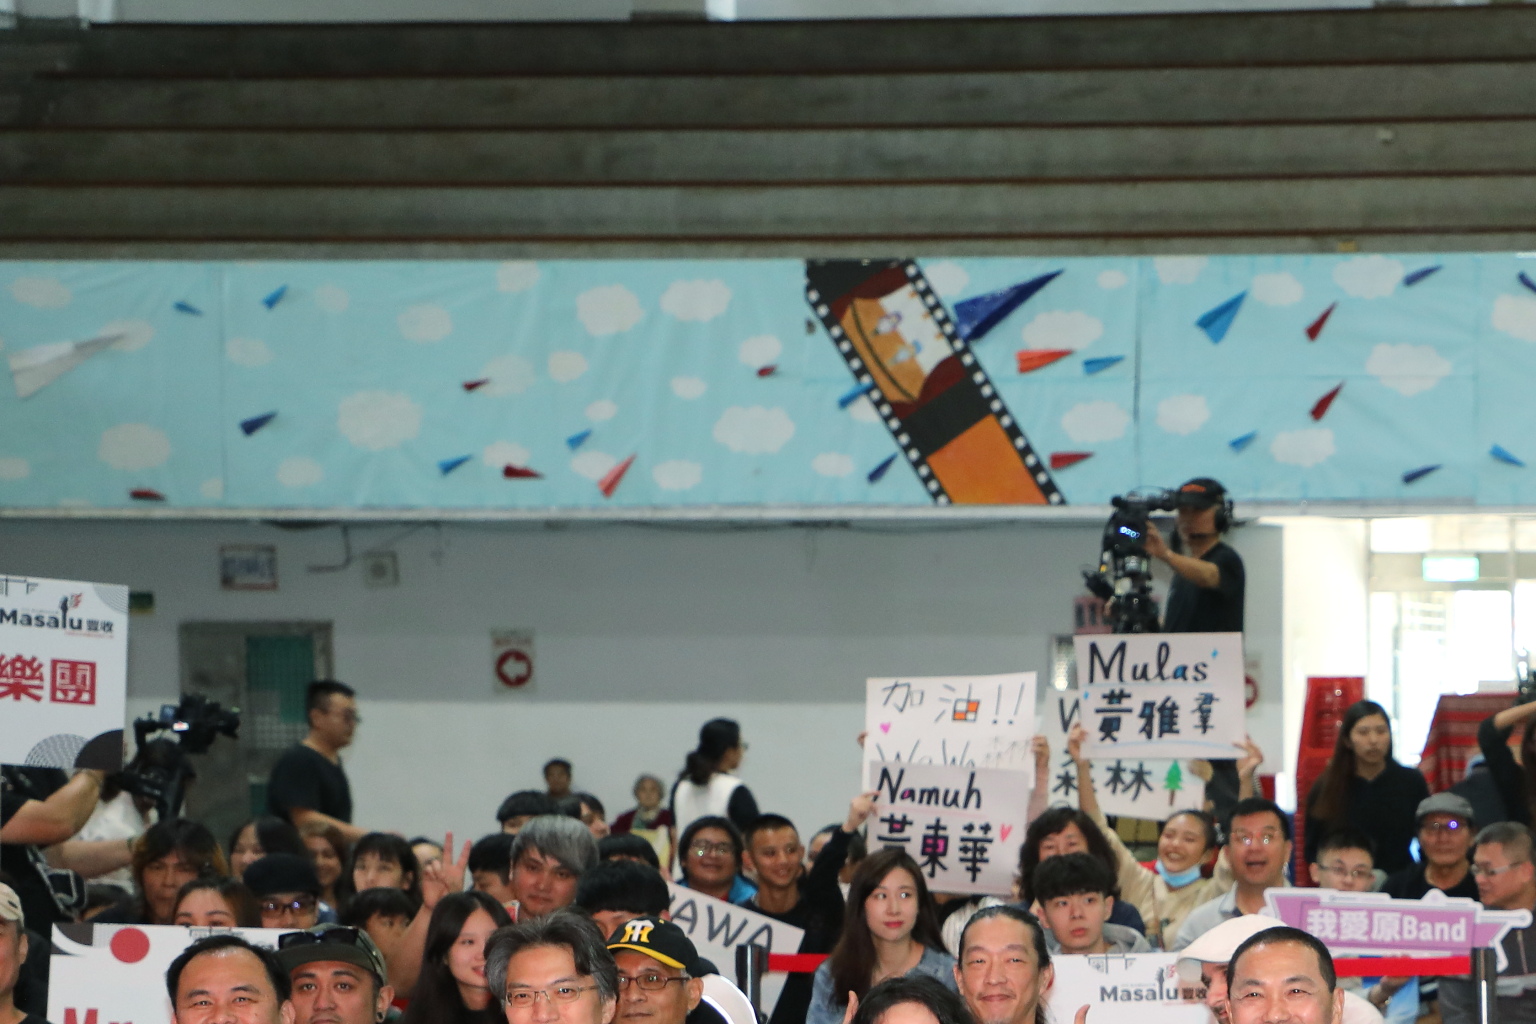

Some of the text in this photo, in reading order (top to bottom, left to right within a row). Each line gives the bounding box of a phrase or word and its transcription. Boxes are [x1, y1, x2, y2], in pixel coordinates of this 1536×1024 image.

[0, 600, 82, 631] Masalu
[1089, 640, 1209, 684] Mulas
[873, 766, 982, 810] Namuh
[1306, 908, 1467, 943] 我愛原Band
[1100, 975, 1179, 1002] Masalu
